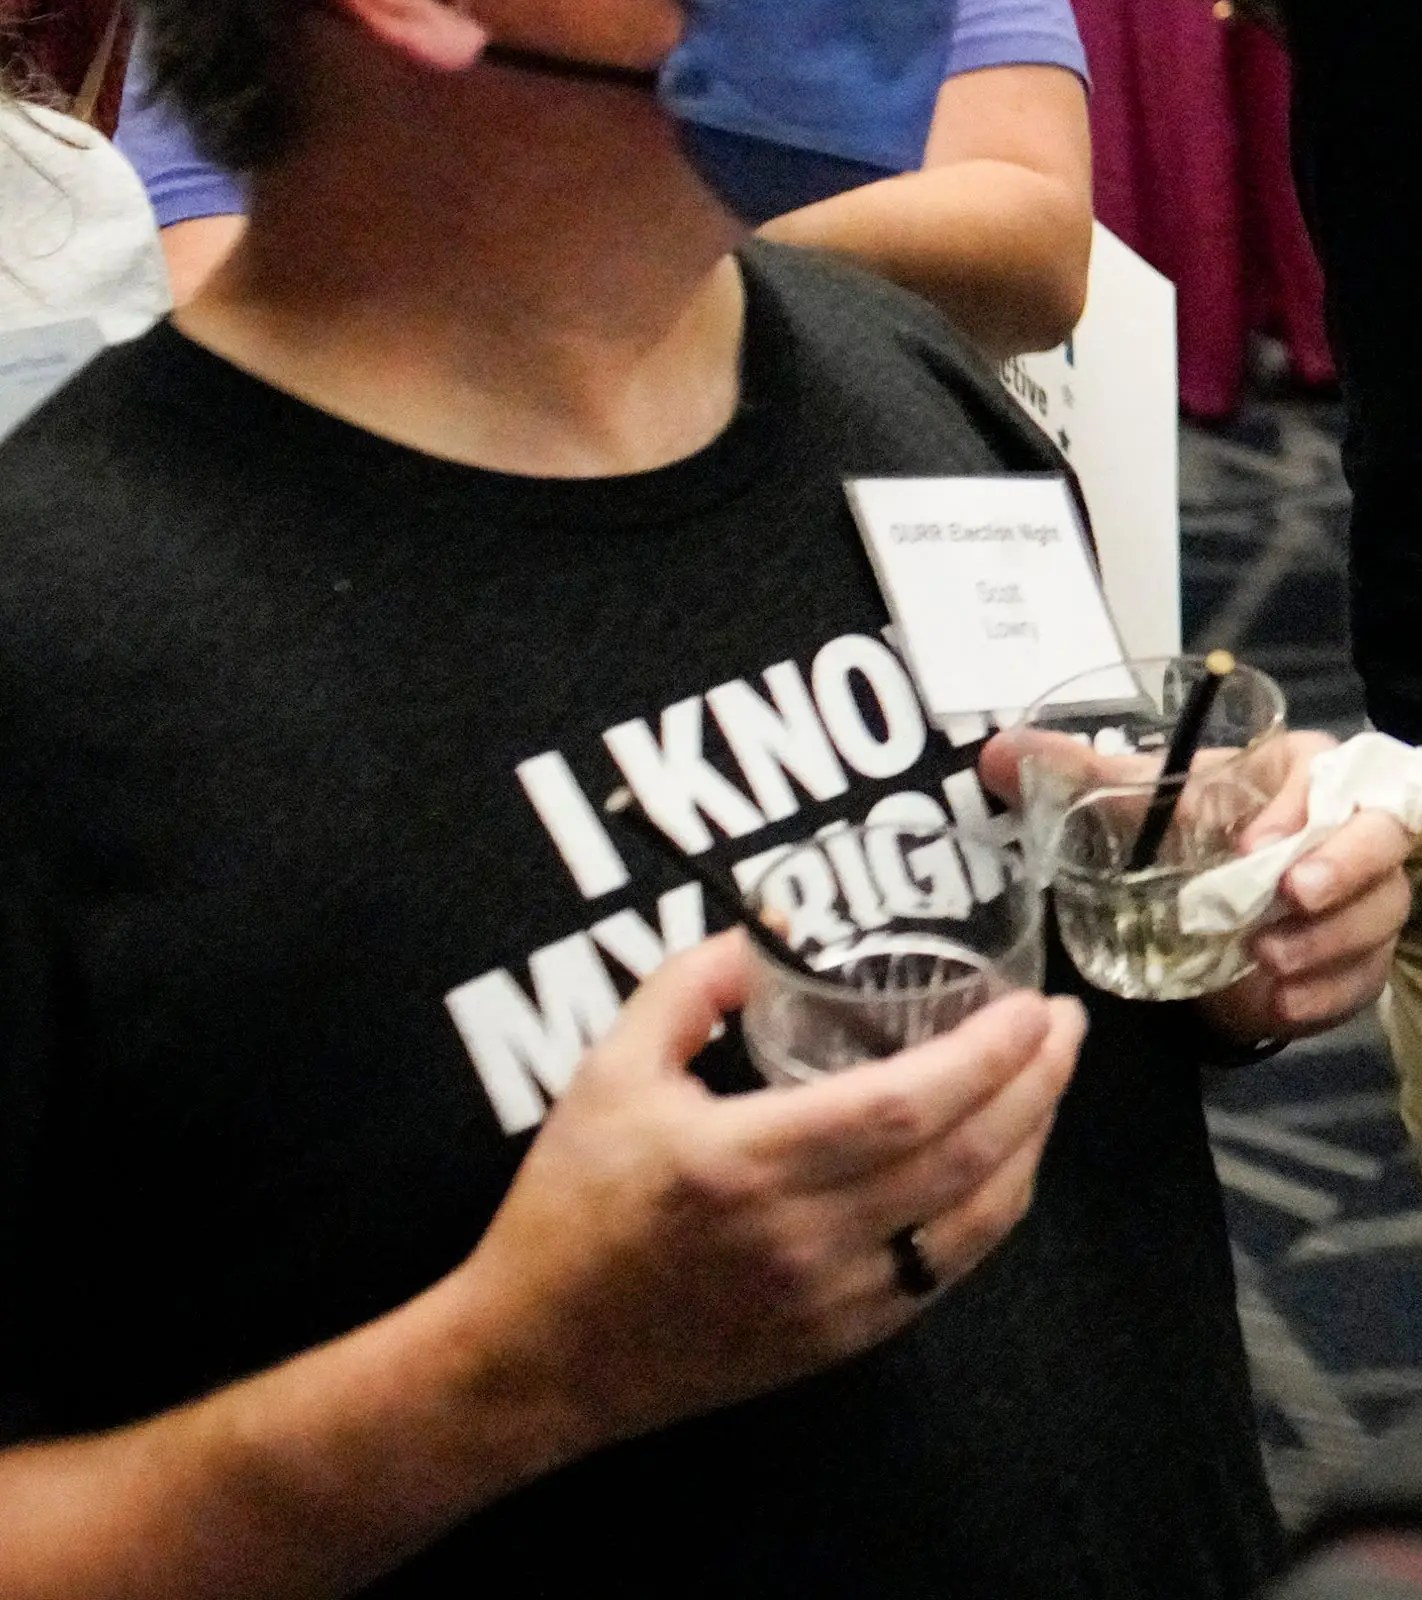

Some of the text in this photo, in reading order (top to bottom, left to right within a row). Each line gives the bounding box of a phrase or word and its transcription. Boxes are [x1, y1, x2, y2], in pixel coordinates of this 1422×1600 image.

[515, 624, 1012, 900] I KNO
[445, 766, 1030, 1136] MY RIGH
